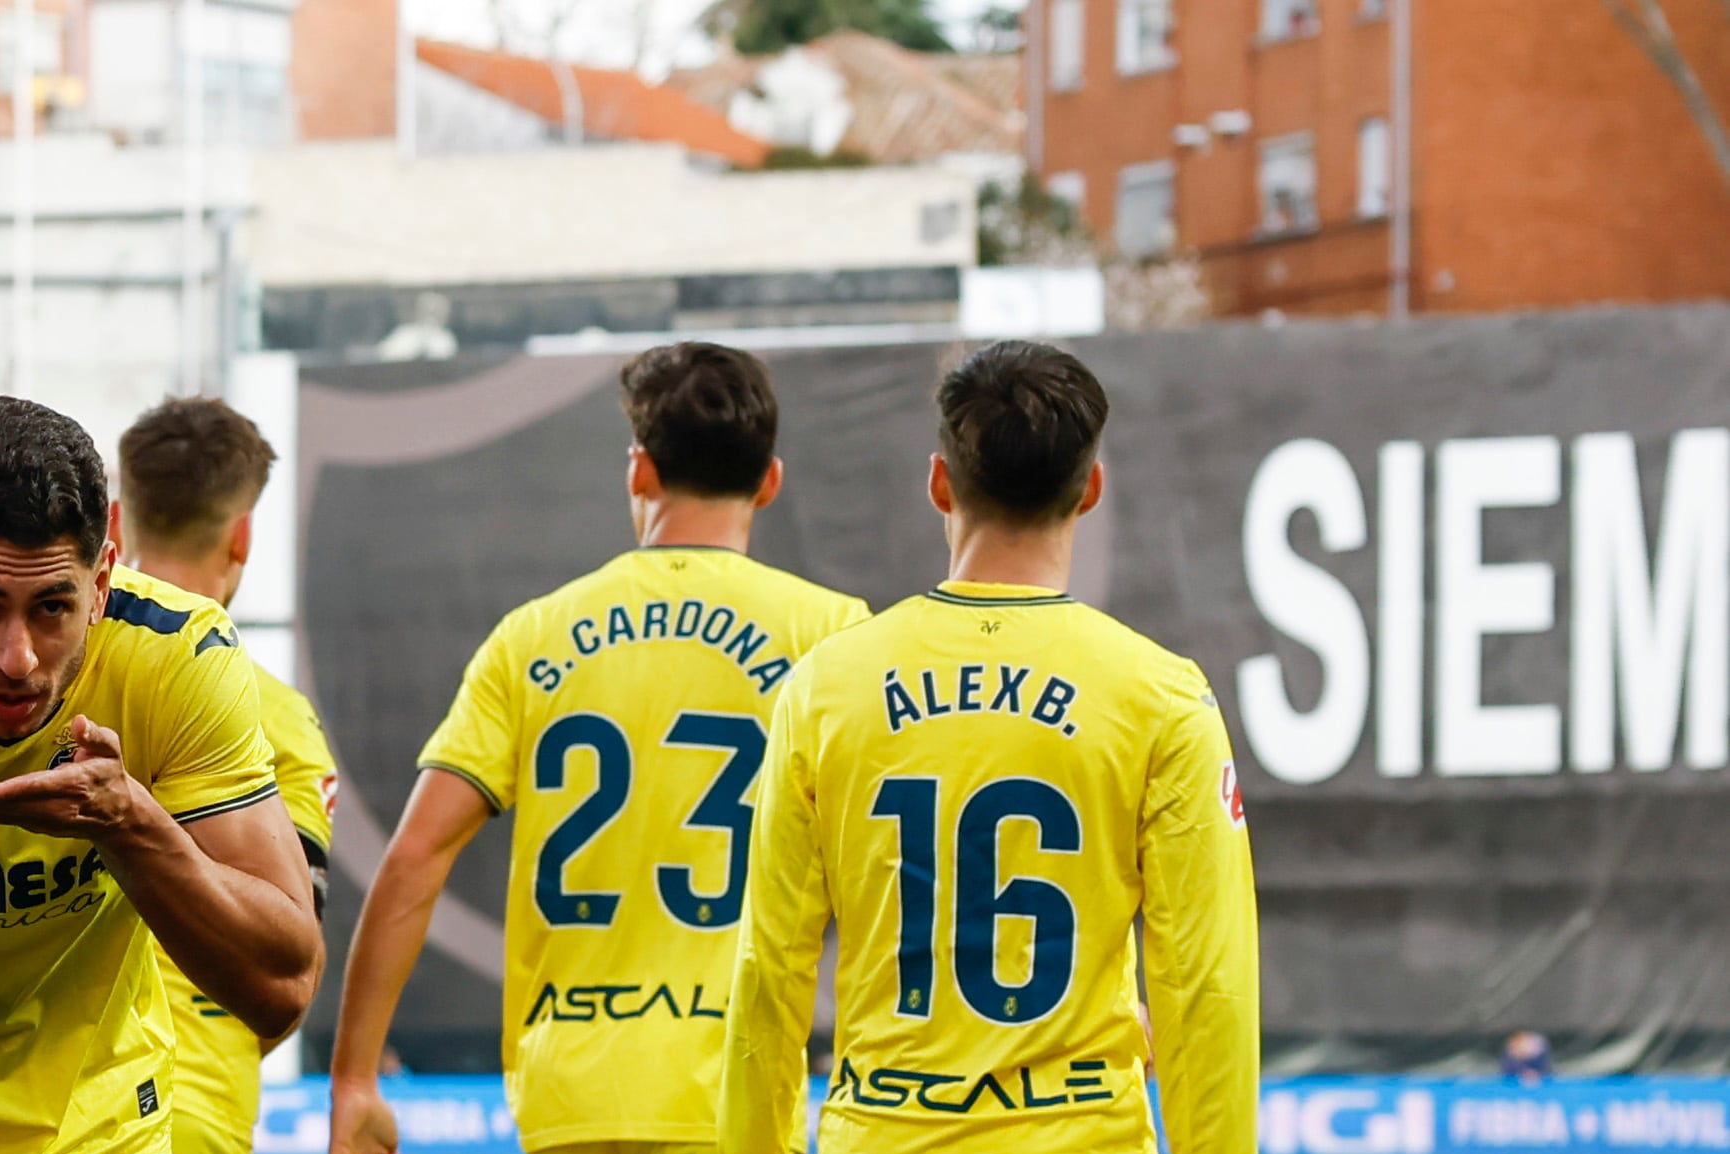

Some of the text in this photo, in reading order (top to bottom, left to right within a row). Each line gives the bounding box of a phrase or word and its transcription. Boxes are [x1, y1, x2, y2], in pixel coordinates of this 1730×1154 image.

[1236, 427, 1730, 785] SIEM
[530, 706, 769, 933] 23
[866, 775, 1083, 1027] 16
[524, 982, 730, 1027] ASCAL
[830, 1058, 1114, 1114] ASCALE
